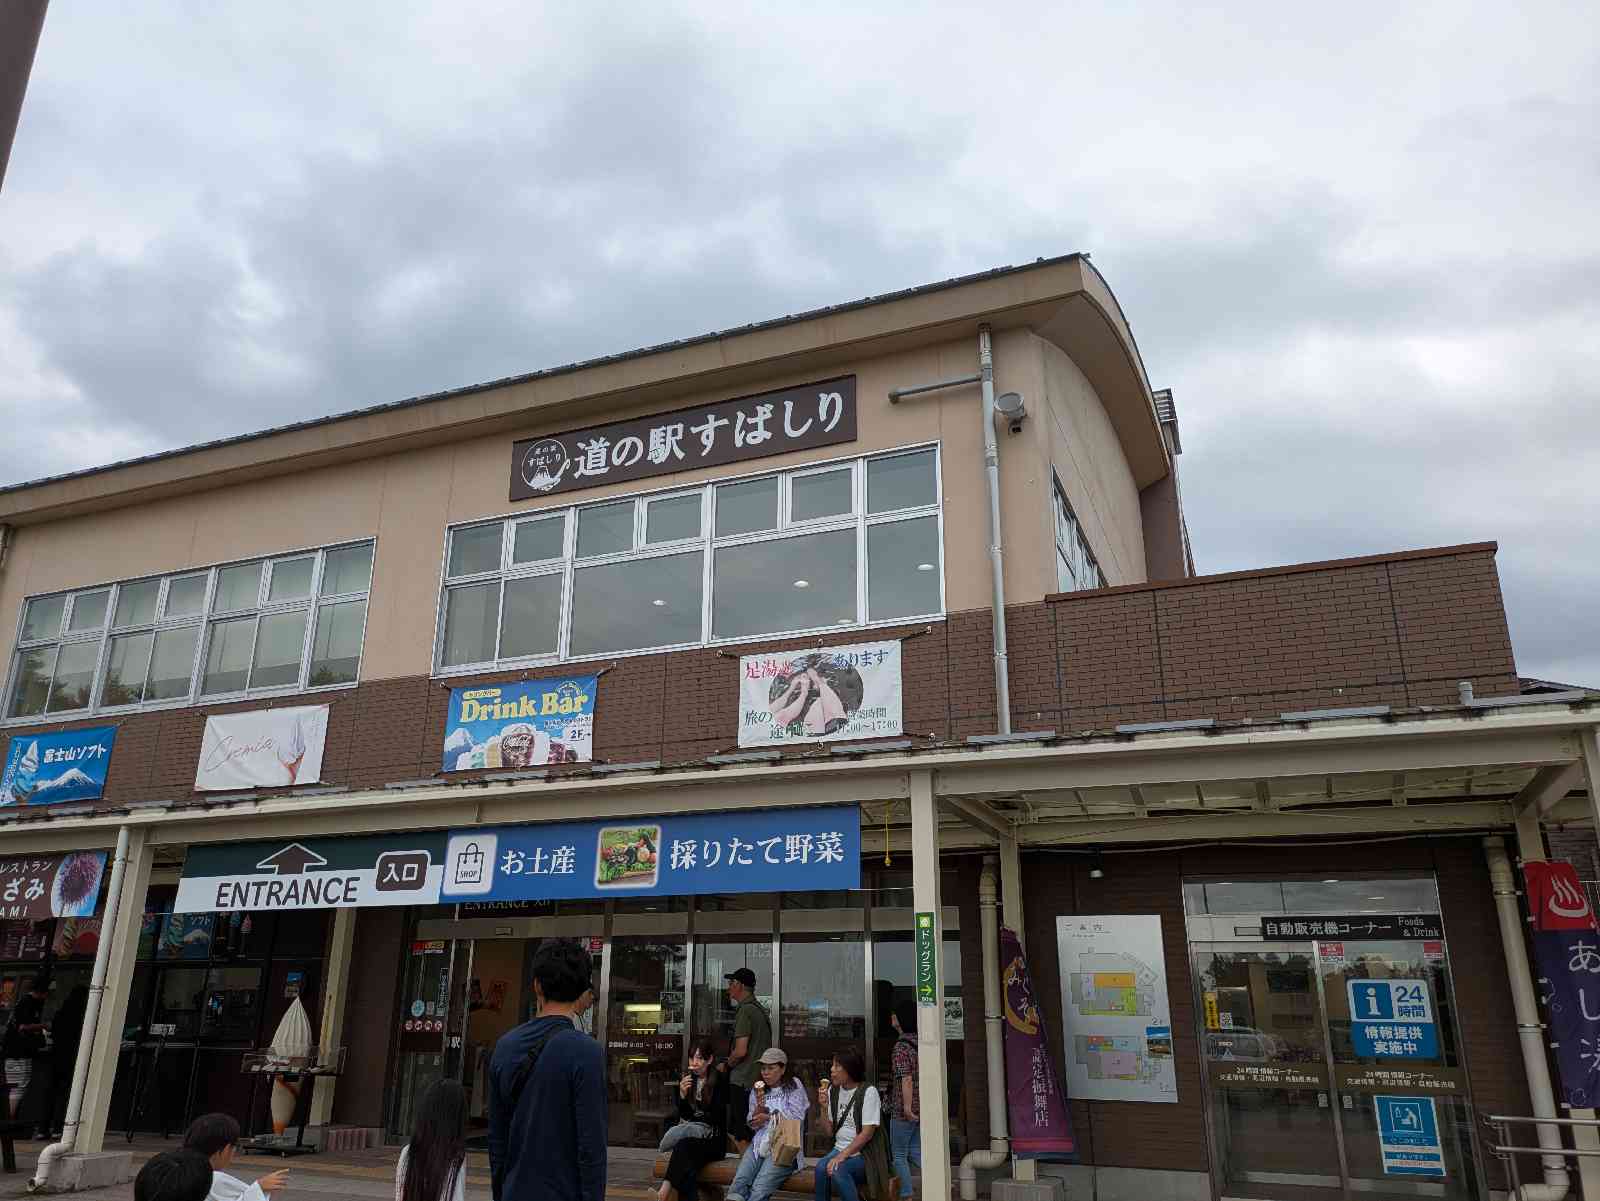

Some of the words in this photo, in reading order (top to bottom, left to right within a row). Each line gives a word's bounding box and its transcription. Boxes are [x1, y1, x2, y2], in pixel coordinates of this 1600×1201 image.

[573, 392, 843, 479] 道の駅すばしり
[832, 649, 889, 669] あります
[460, 695, 537, 722] Drink
[540, 692, 588, 715] Bar
[570, 728, 583, 740] 2F
[43, 743, 107, 763] 富士山ソフト
[670, 831, 845, 870] 採りたて野菜
[0, 860, 53, 874] レストラン
[500, 845, 577, 875] お土産
[382, 863, 419, 883] 入口
[459, 869, 478, 879] SHOP
[216, 876, 361, 908] ENTRANCE
[1266, 921, 1392, 936] 自動販売機コーナー
[1414, 927, 1440, 937] Drink
[920, 929, 933, 983] ドッグラン
[1395, 986, 1424, 1002] 24
[1398, 1005, 1426, 1017] 時間
[1364, 1025, 1423, 1040] 情報提供
[1374, 1040, 1418, 1055] 実施中
